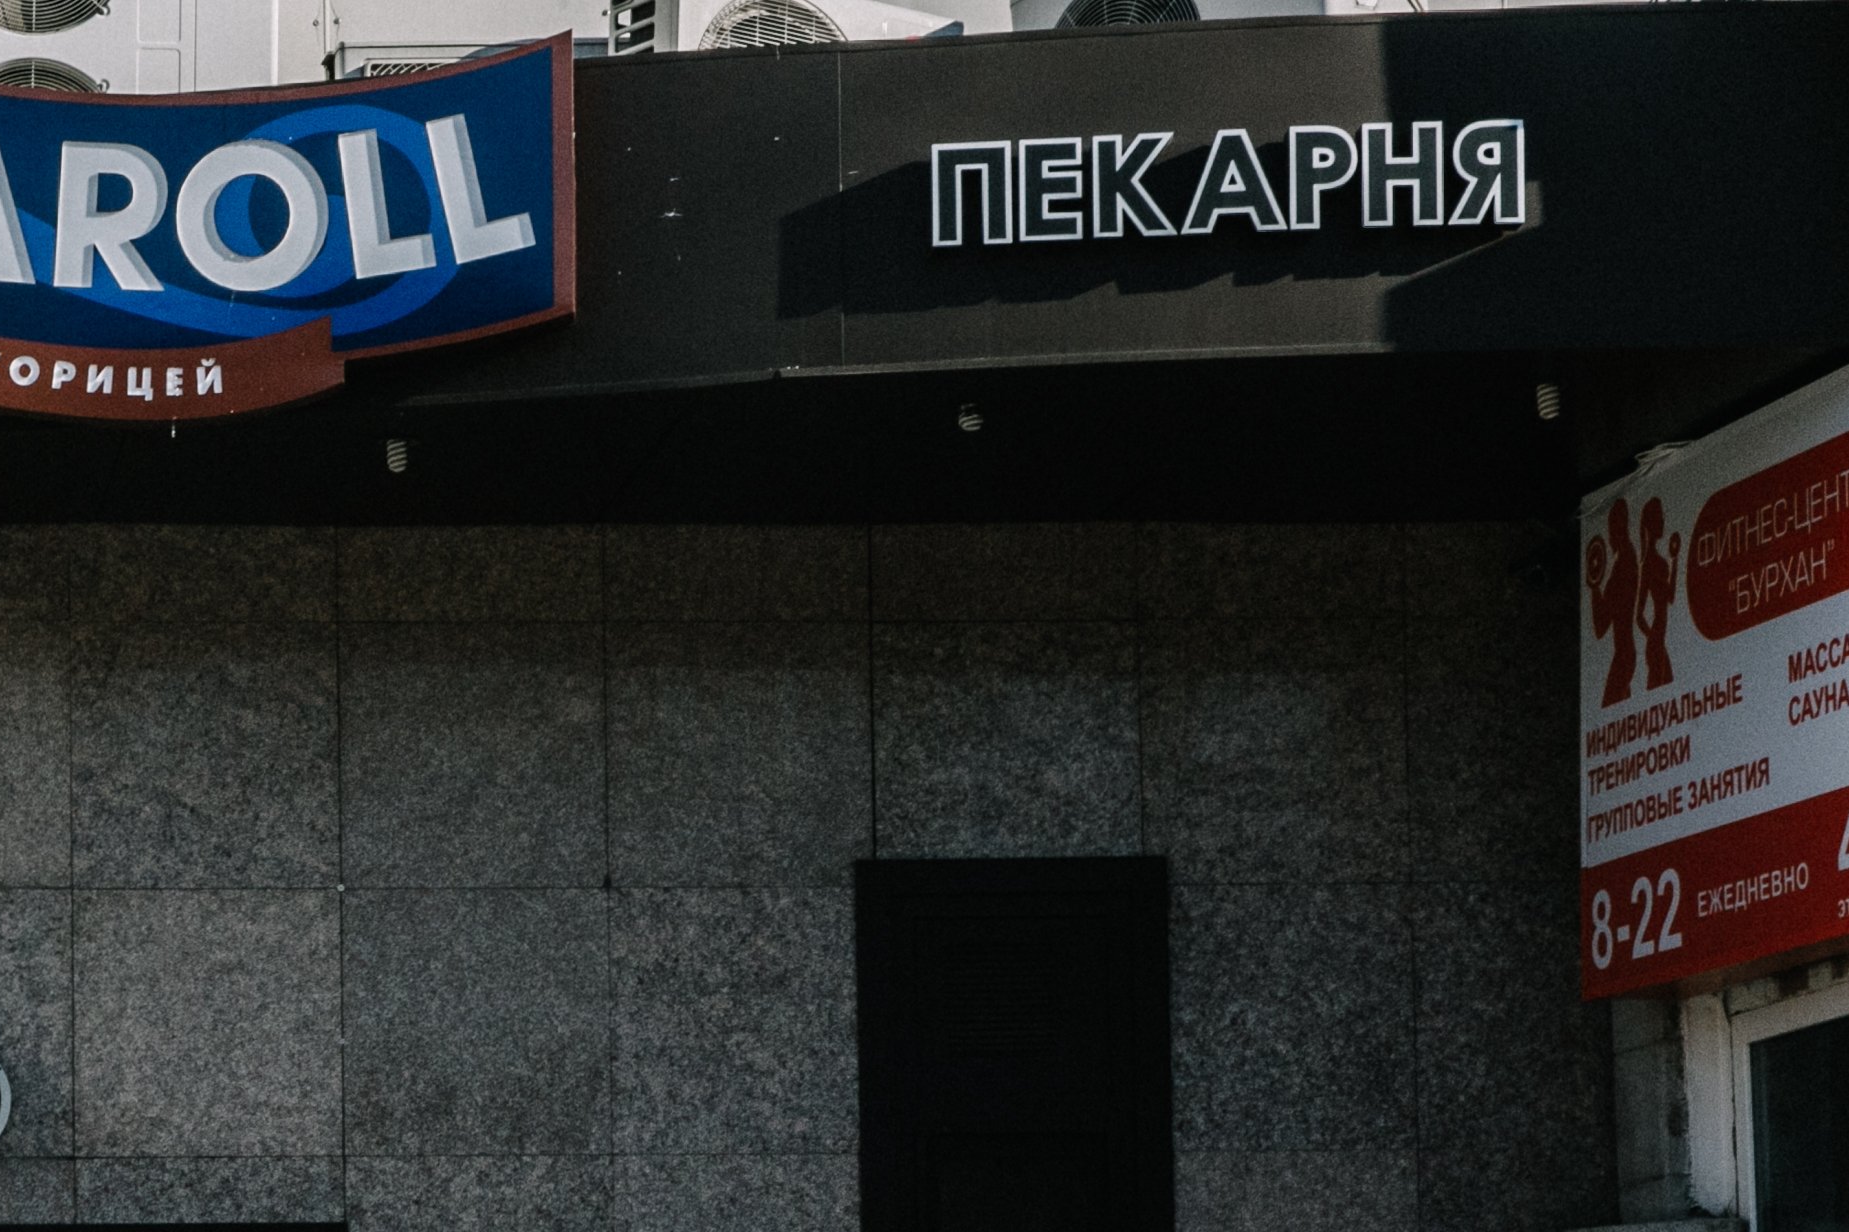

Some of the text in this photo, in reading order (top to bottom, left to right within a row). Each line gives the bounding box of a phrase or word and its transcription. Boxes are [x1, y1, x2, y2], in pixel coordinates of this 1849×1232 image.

[931, 119, 1526, 246] ПЕКАРНЯ
[1586, 673, 1744, 758] ИНДИВИДУАЛЬНЫЕ
[1788, 679, 1849, 726] САУНА
[1588, 735, 1691, 796] ТРЕНИРОВКИ
[1588, 756, 1770, 844] ГРУППОВЫЕ ЗАНЯТИЯ
[1592, 868, 1682, 970] 8-22
[1698, 862, 1809, 918] ЕЖЕДНЕВНО
